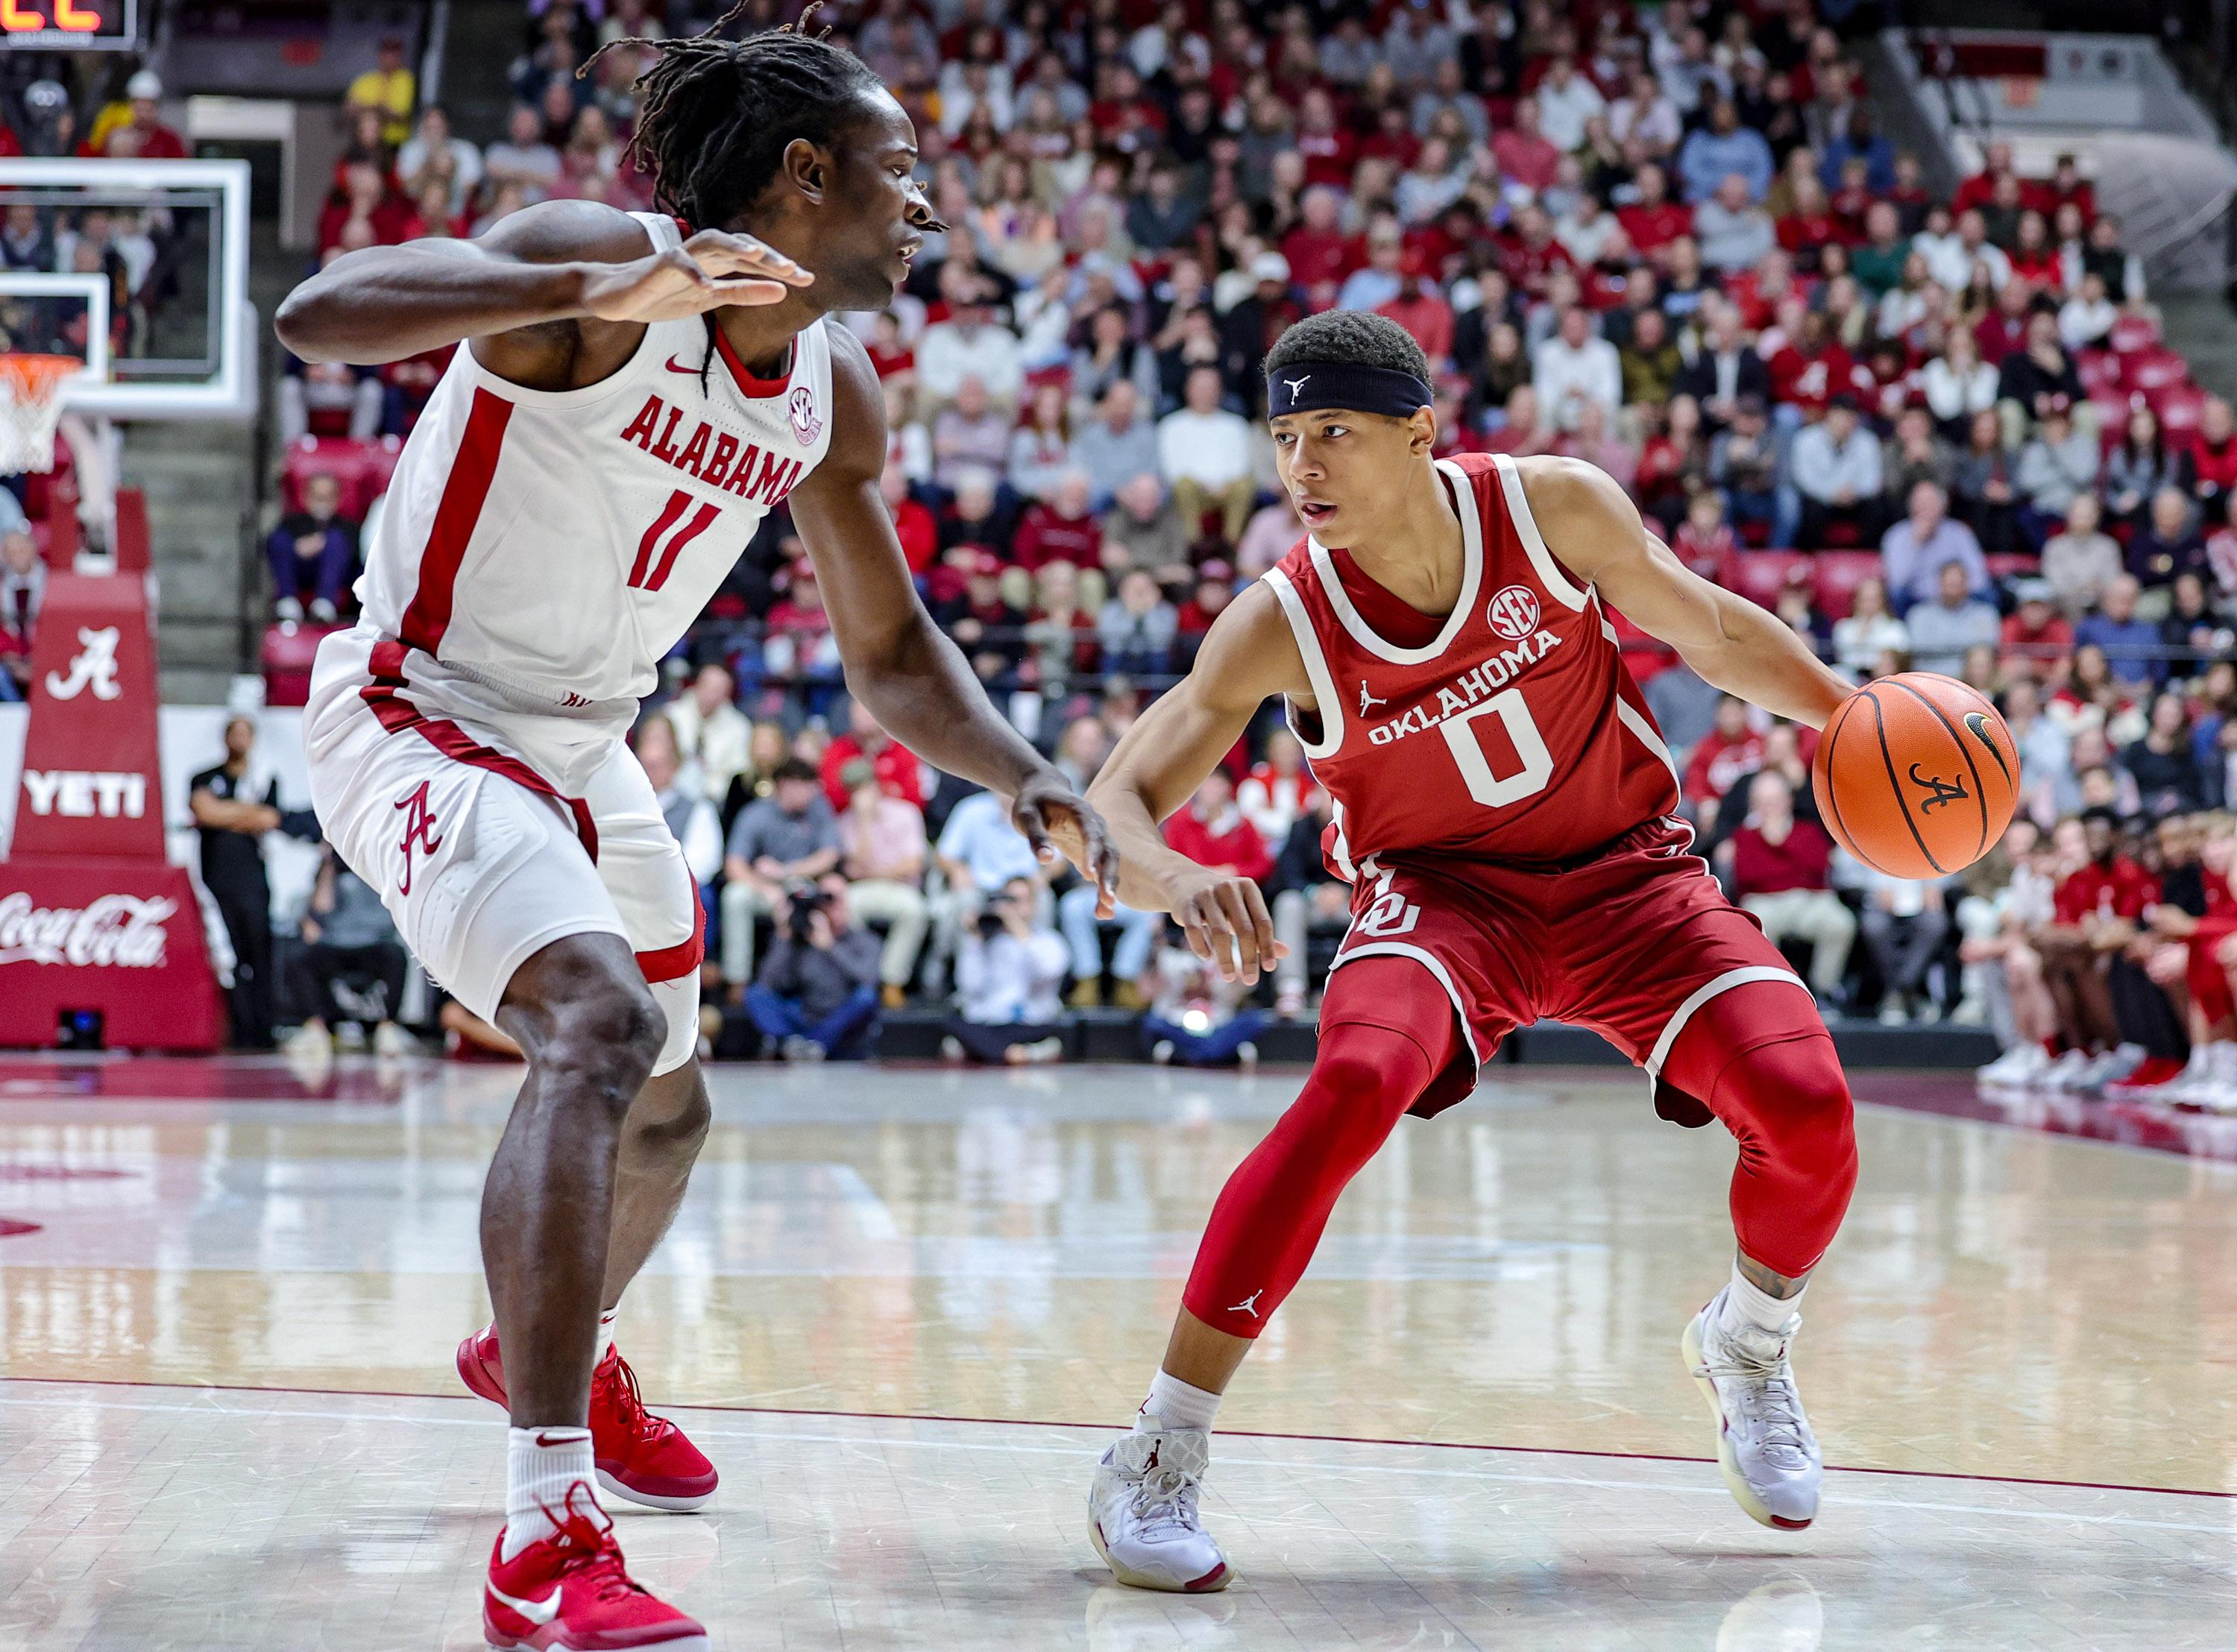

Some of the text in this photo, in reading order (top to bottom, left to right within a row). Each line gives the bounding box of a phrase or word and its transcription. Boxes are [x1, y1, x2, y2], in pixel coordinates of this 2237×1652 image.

[620, 394, 803, 506] ALABAMA
[790, 387, 812, 432] SEC
[627, 489, 723, 592] 11
[1491, 589, 1536, 637] SEC
[45, 626, 122, 701] A
[1368, 629, 1563, 745] OKLAHOMA
[1438, 687, 1555, 809] 0
[1909, 763, 1969, 815] A
[23, 769, 146, 819] YETI
[394, 780, 443, 896] A
